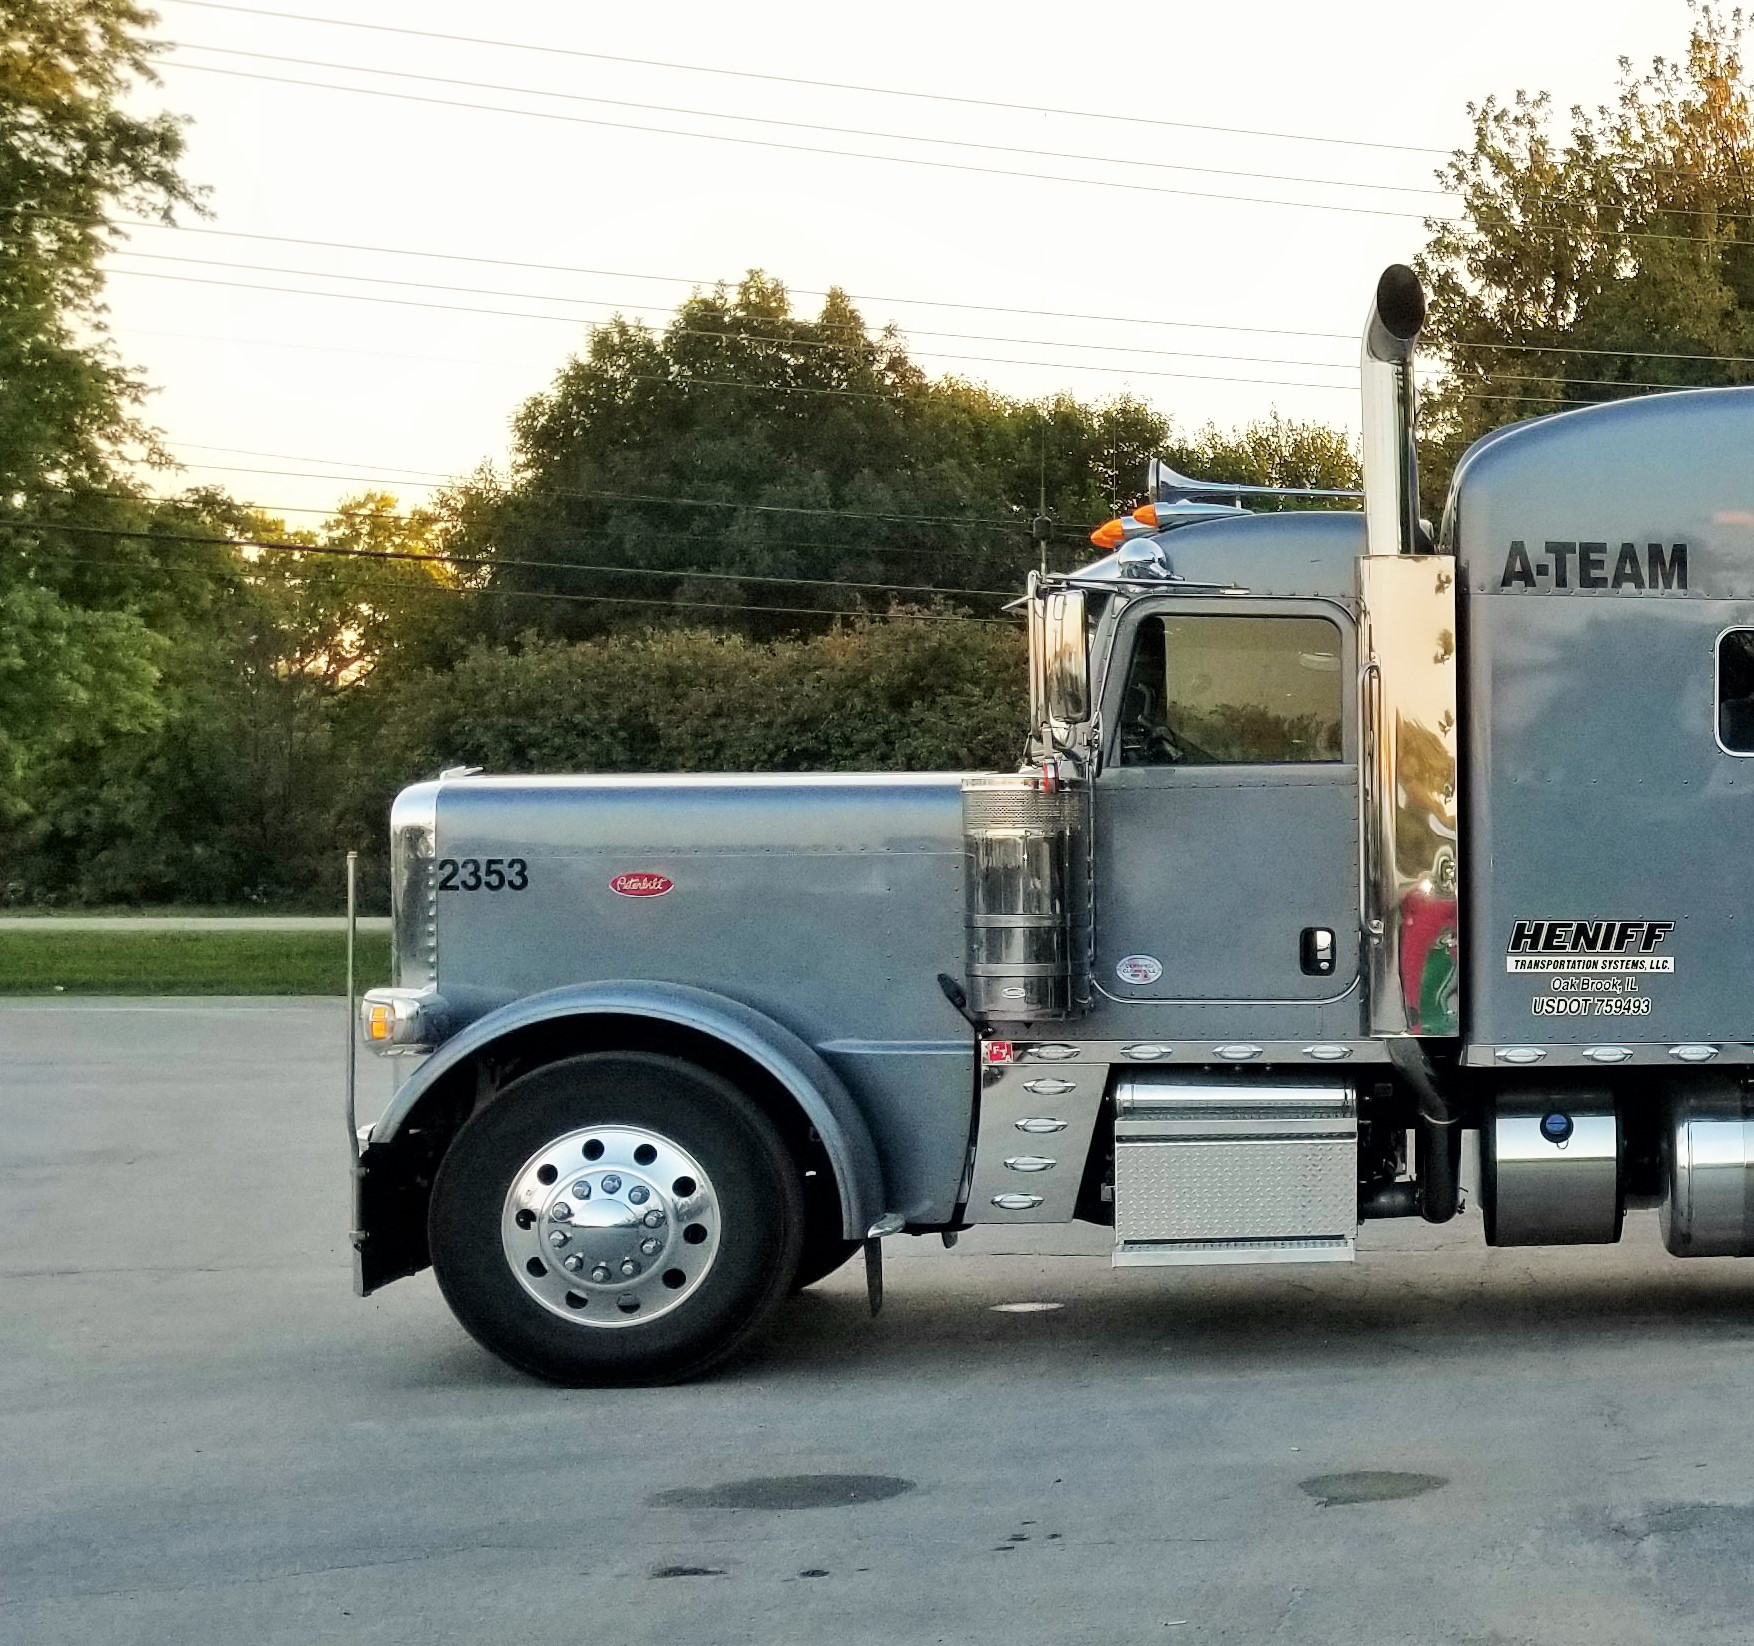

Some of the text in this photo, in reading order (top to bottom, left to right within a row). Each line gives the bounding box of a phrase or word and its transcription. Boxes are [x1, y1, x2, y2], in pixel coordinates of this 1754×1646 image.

[1501, 541, 1687, 590] A-TEAM
[438, 858, 529, 891] 2353
[1507, 920, 1676, 953] HENIFF
[1514, 959, 1670, 971] TRANSPORTATION SYSTEMS, LLC.
[1552, 977, 1638, 994] Oak Brook, IL
[1532, 997, 1651, 1015] USDOT 759493
